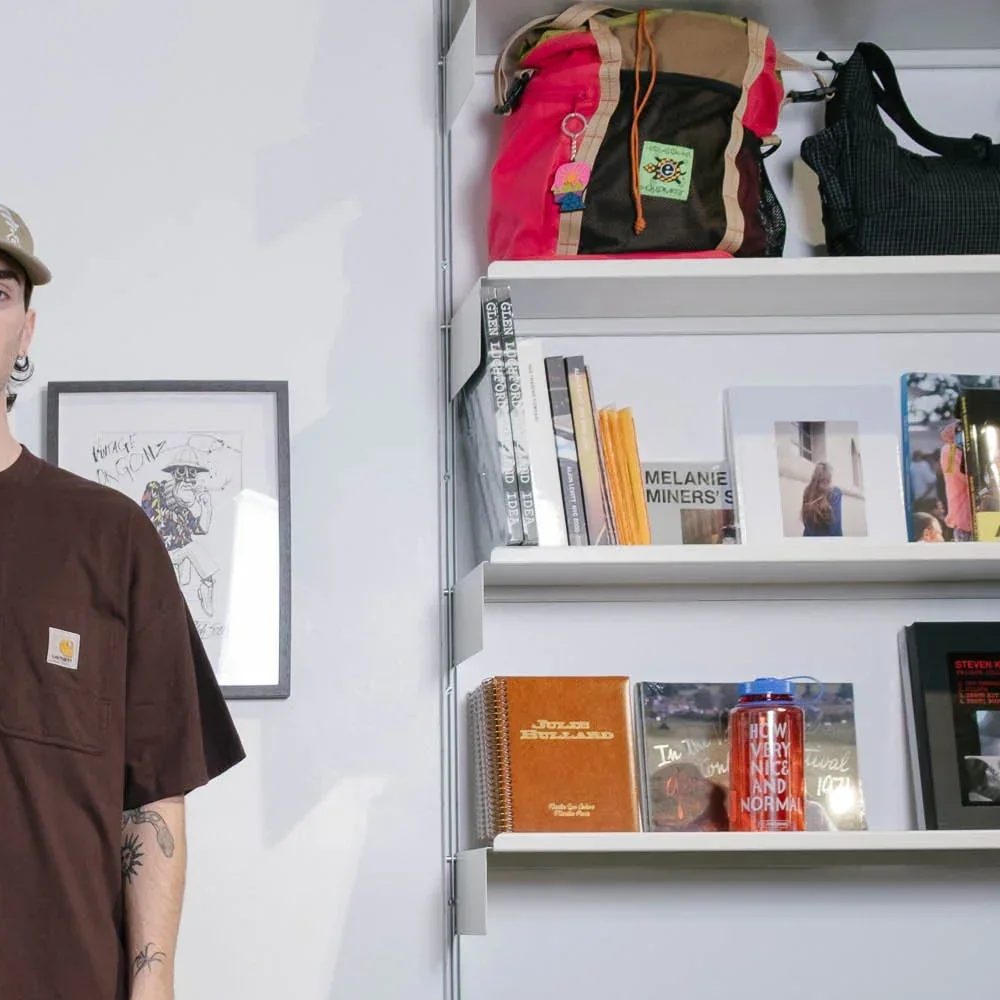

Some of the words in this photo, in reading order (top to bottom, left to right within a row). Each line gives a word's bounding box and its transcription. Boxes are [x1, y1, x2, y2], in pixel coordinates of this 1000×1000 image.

[486, 302, 499, 336] GLEN
[500, 302, 514, 336] GLEN
[645, 470, 728, 486] MELANIE
[646, 489, 719, 504] MINERS'
[749, 722, 787, 740] HOW
[653, 744, 683, 767] In
[750, 742, 791, 758] VERY
[750, 760, 789, 776] NICE
[752, 778, 787, 794] AND
[740, 796, 803, 812] NORMAL
